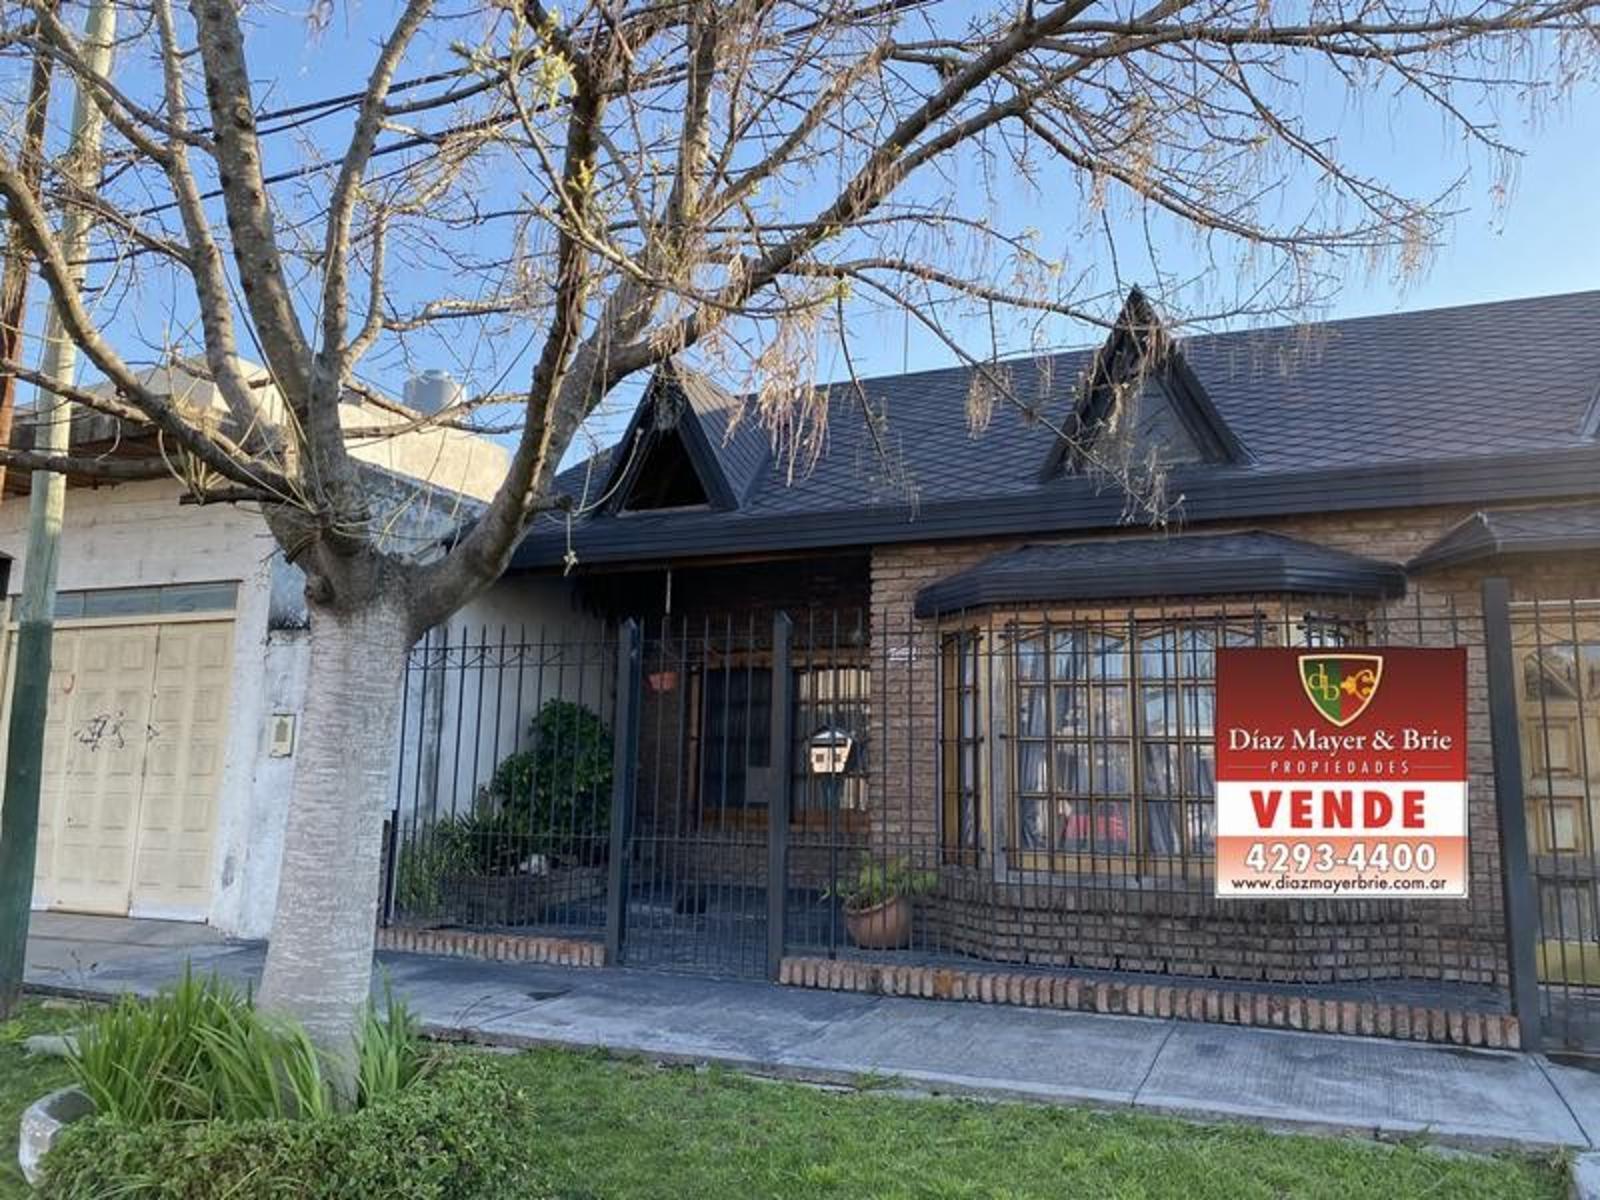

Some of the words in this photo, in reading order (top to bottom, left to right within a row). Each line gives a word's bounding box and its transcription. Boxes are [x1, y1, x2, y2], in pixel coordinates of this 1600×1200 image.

[1229, 728, 1285, 751] Díaz
[1291, 728, 1366, 757] Mayer
[1371, 729, 1395, 751] &
[1402, 728, 1452, 751] Brie
[1270, 760, 1410, 774] PROPIEDADES
[1249, 790, 1425, 829] VENDE
[1245, 842, 1437, 874] 4293-4400
[1231, 874, 1447, 893] www.diazmayerbrie.com.ar
